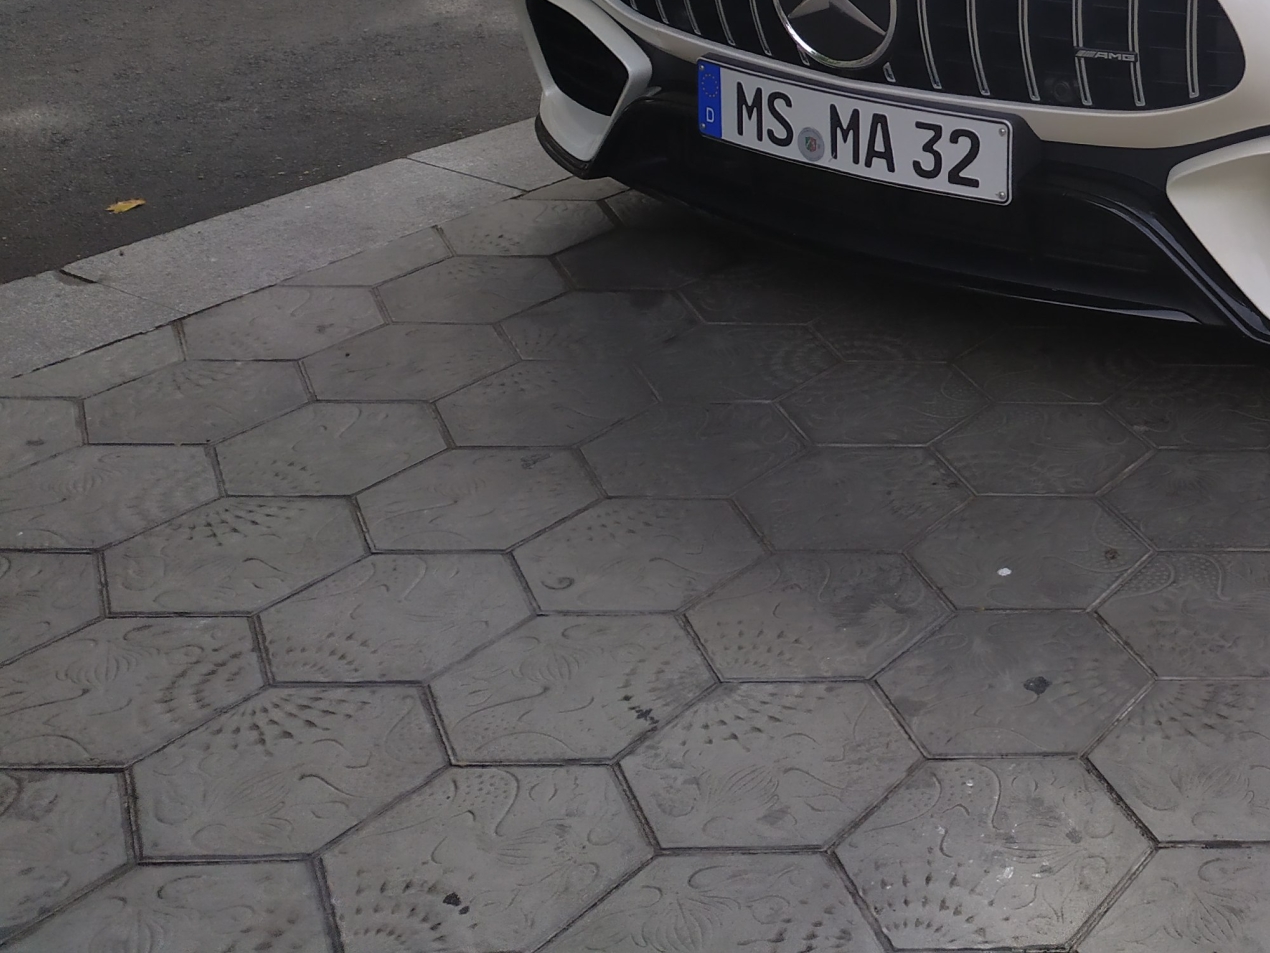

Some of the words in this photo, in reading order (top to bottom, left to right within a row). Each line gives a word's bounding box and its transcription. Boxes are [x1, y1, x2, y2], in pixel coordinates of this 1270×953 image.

[1094, 51, 1136, 62] AMG
[706, 107, 715, 123] D
[736, 81, 794, 147] MS
[829, 103, 896, 173] MA
[912, 120, 981, 189] 32
